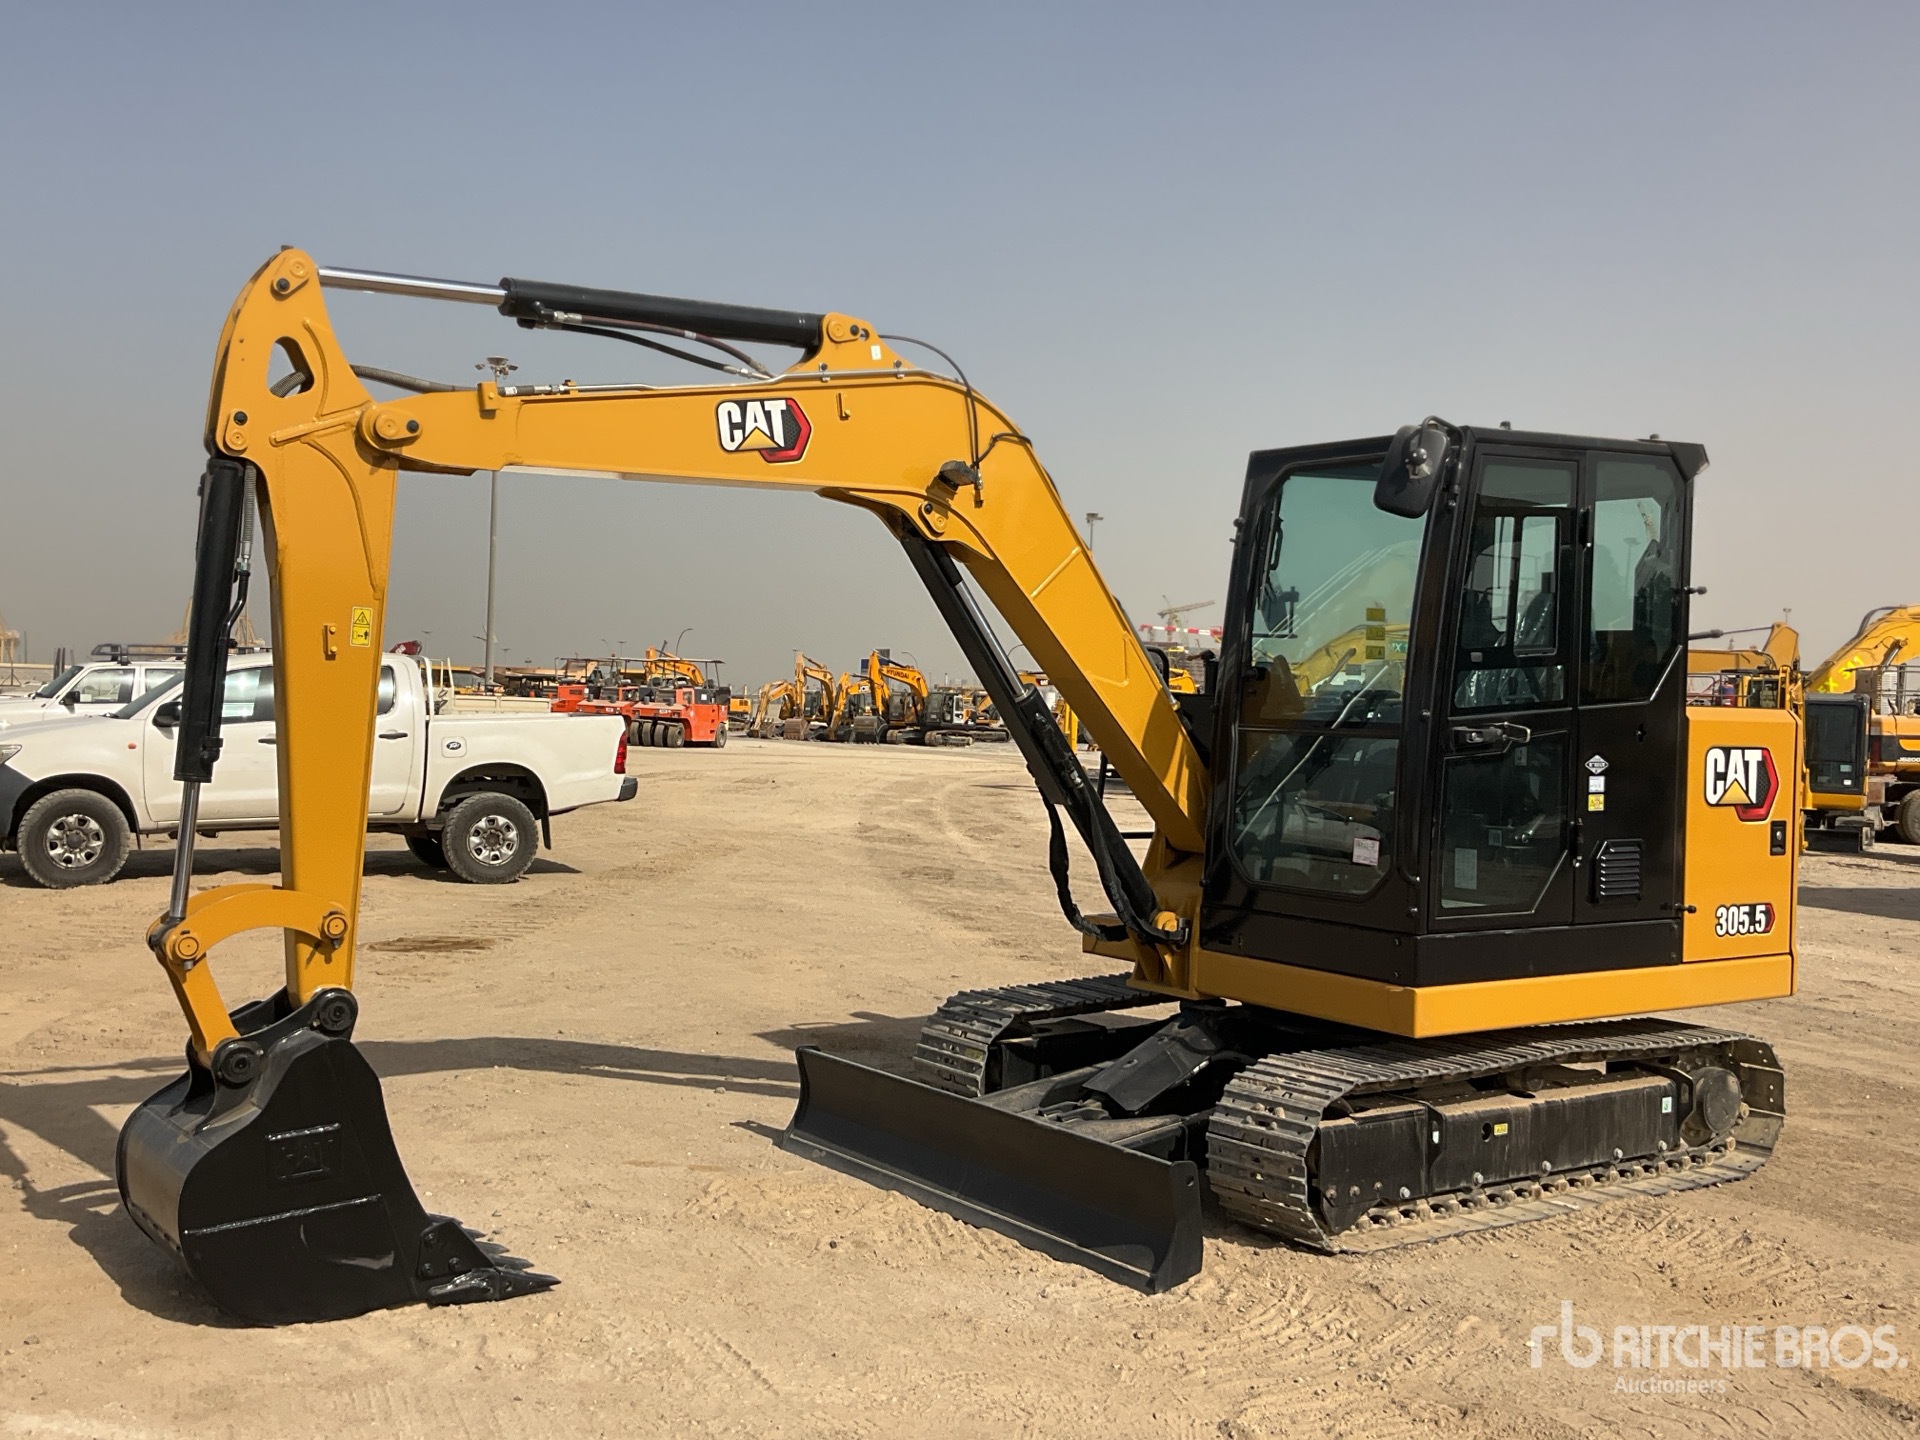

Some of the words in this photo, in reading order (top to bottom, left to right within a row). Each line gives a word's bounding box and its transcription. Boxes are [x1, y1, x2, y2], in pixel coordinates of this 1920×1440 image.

[717, 399, 787, 451] CAT
[886, 669, 910, 679] HYUNDAI
[1705, 747, 1763, 805] CAT
[1715, 904, 1767, 936] 305.5
